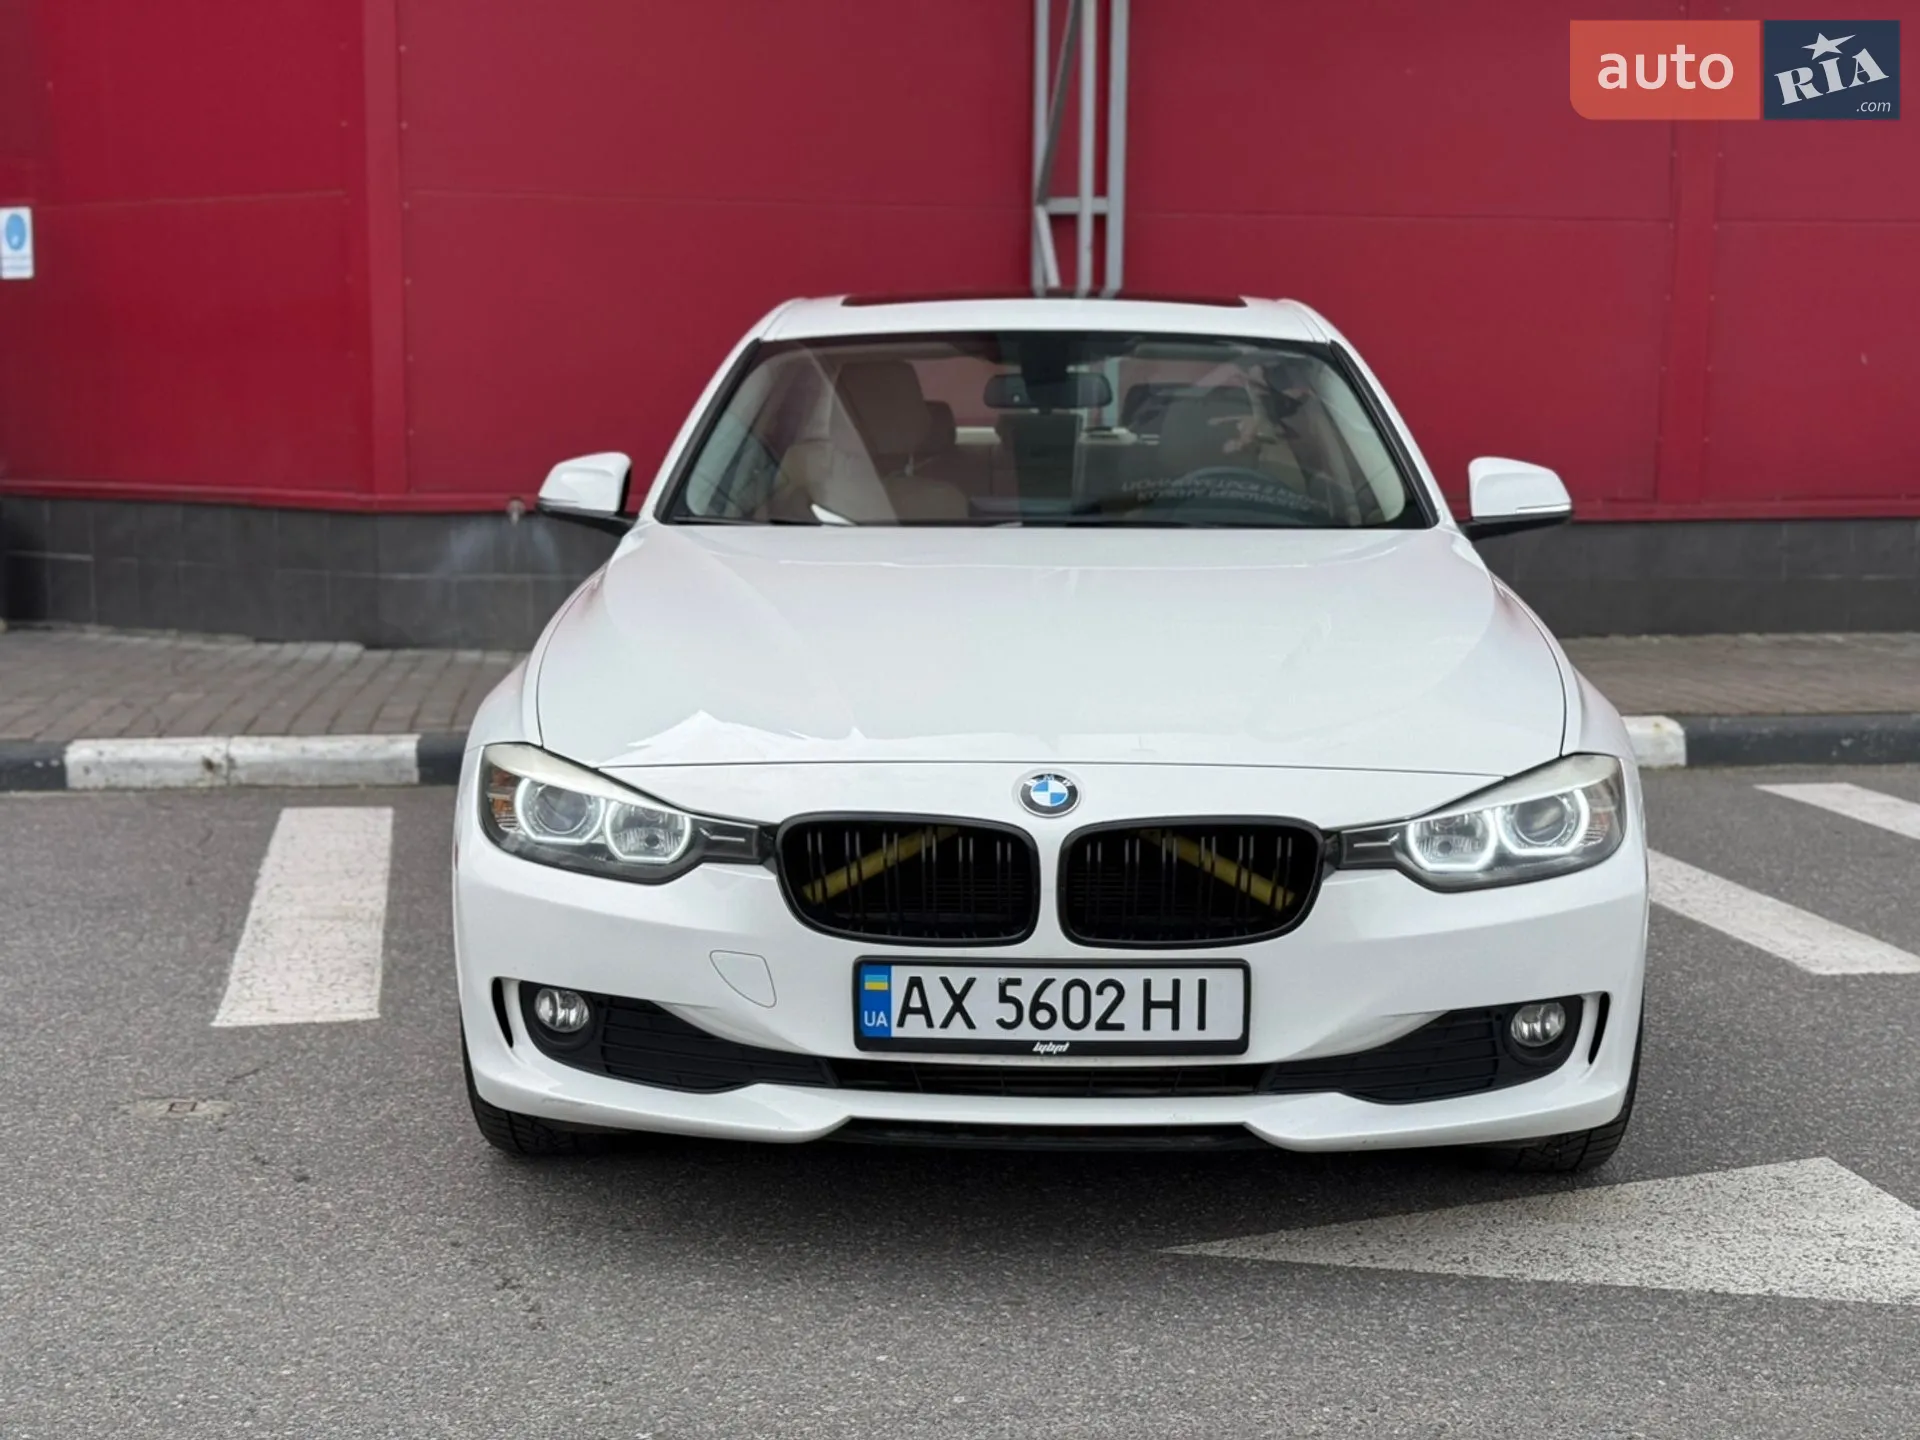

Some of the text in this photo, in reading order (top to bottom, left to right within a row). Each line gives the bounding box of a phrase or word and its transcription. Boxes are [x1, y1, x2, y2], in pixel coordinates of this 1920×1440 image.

[863, 1010, 889, 1028] UA
[896, 976, 1207, 1032] AX 5602 HI
